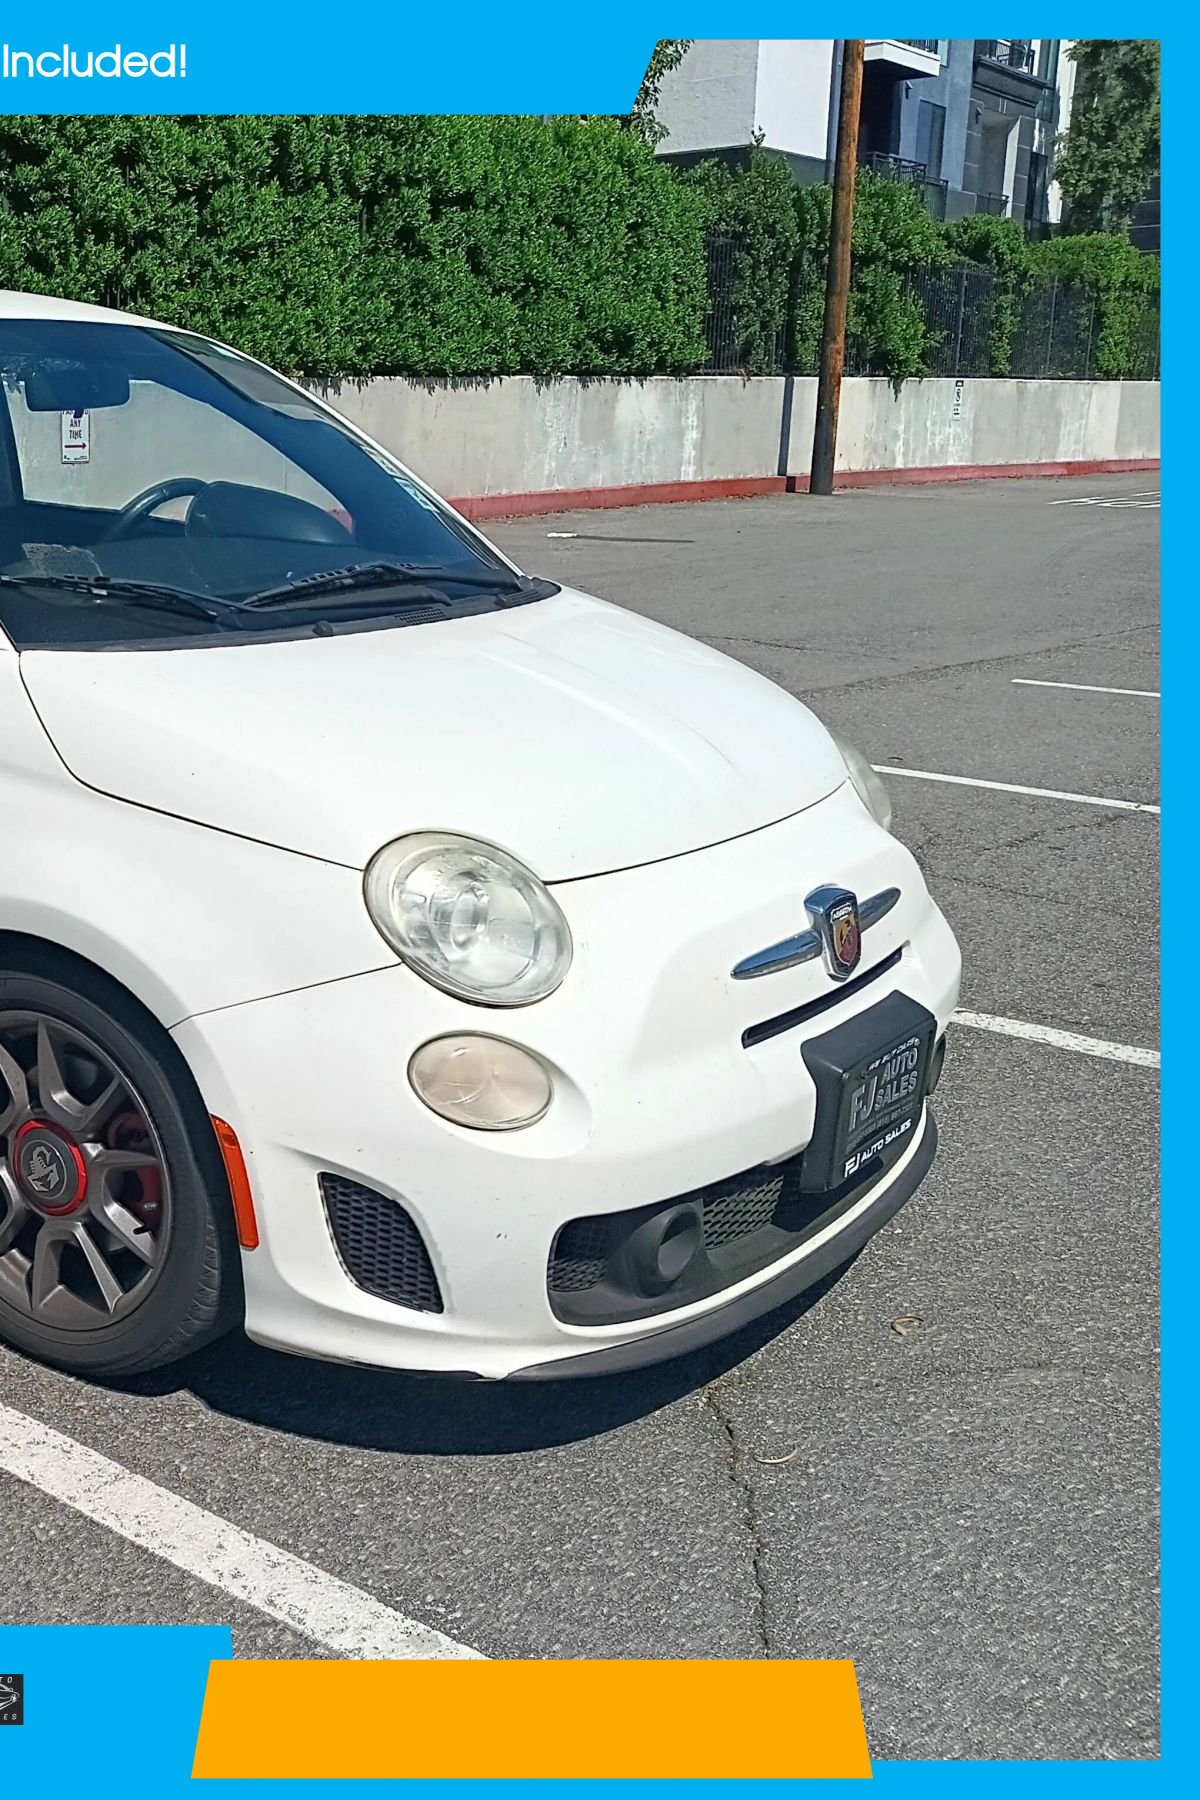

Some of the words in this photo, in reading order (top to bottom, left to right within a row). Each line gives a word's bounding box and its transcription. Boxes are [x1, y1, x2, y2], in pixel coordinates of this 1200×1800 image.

[69, 430, 82, 439] TIME
[70, 419, 81, 428] ANY
[880, 1047, 918, 1086] AUTO
[848, 1075, 878, 1132] FJ
[874, 1070, 918, 1111] SALES
[844, 1152, 861, 1178] FJ
[860, 1138, 884, 1163] AUTO
[884, 1118, 912, 1145] SALES
